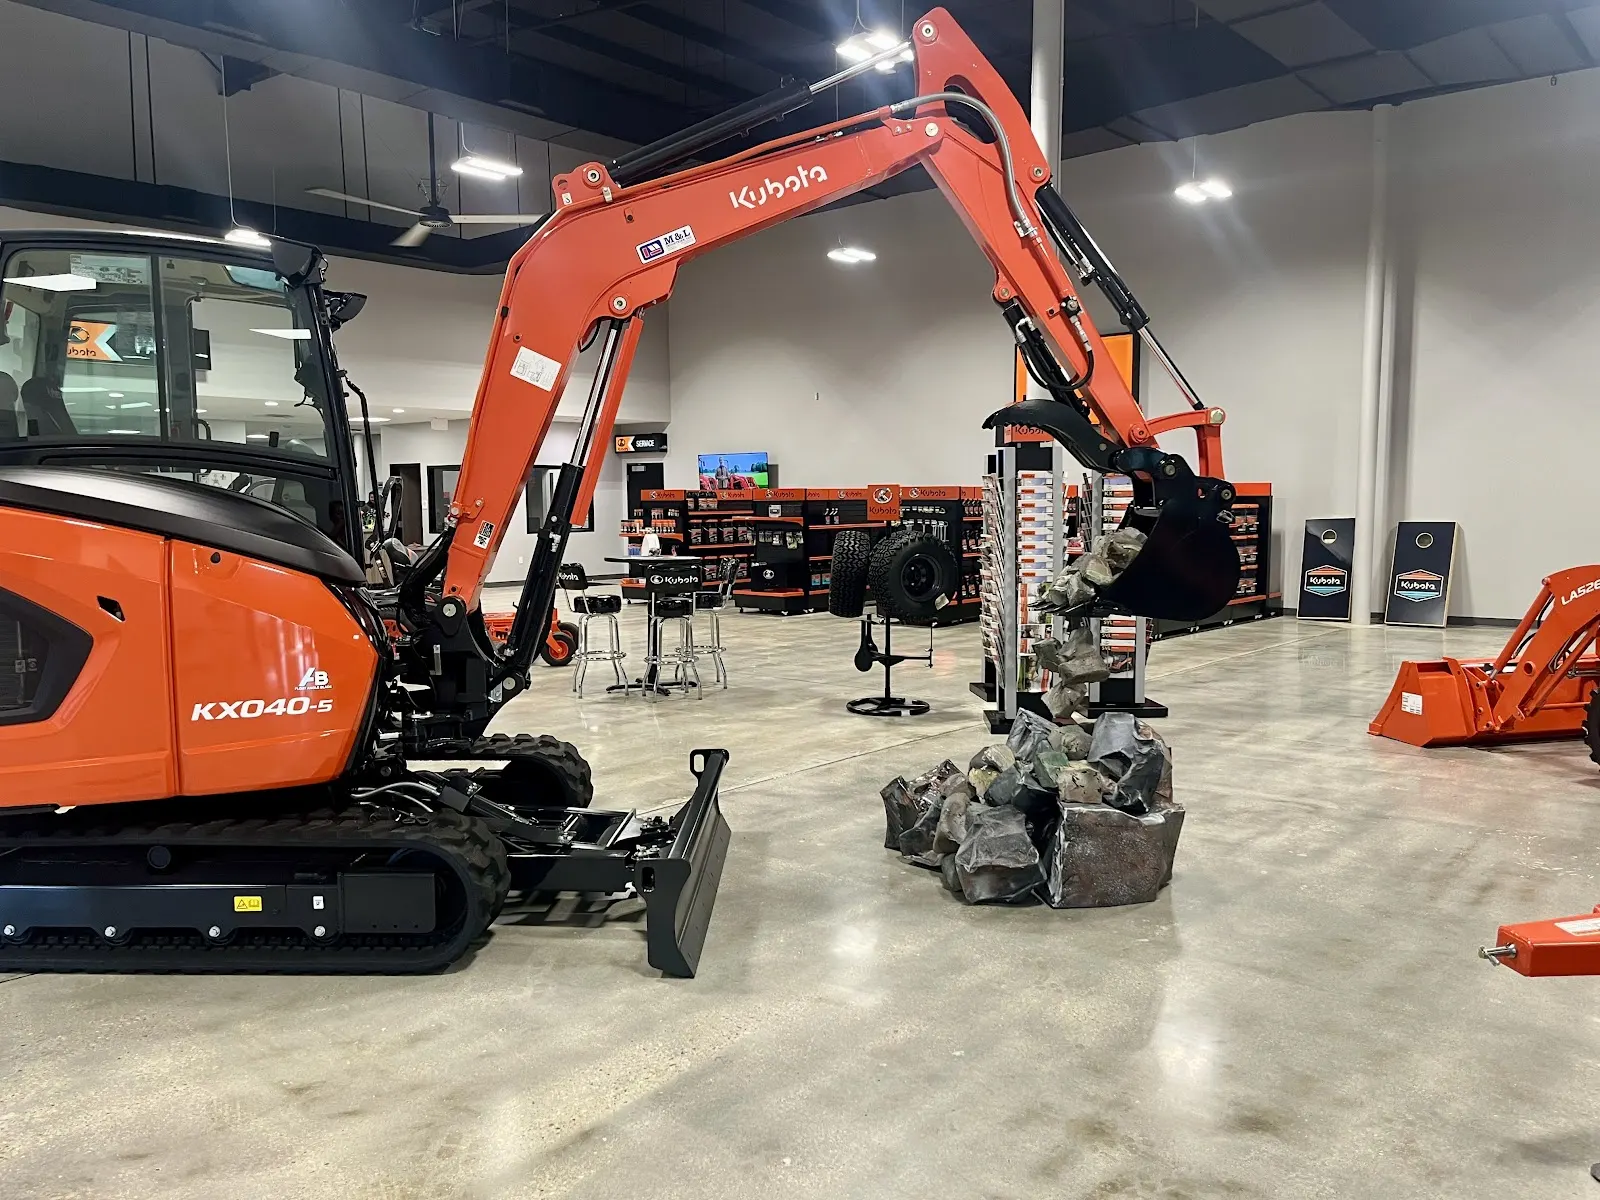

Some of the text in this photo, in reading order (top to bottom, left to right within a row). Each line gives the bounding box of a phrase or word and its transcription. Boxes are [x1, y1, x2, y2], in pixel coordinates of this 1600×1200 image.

[729, 165, 828, 209] Kubota
[663, 234, 675, 246] M
[674, 232, 684, 241] &
[682, 229, 691, 238] L
[635, 439, 655, 448] SERVICE
[773, 490, 795, 498] Kubota
[920, 489, 946, 497] Kubota
[869, 506, 897, 515] Kubota
[664, 575, 699, 585] Kubota
[1309, 576, 1342, 585] Kubota
[1401, 580, 1437, 591] Kubota
[191, 697, 334, 722] KX040-5
